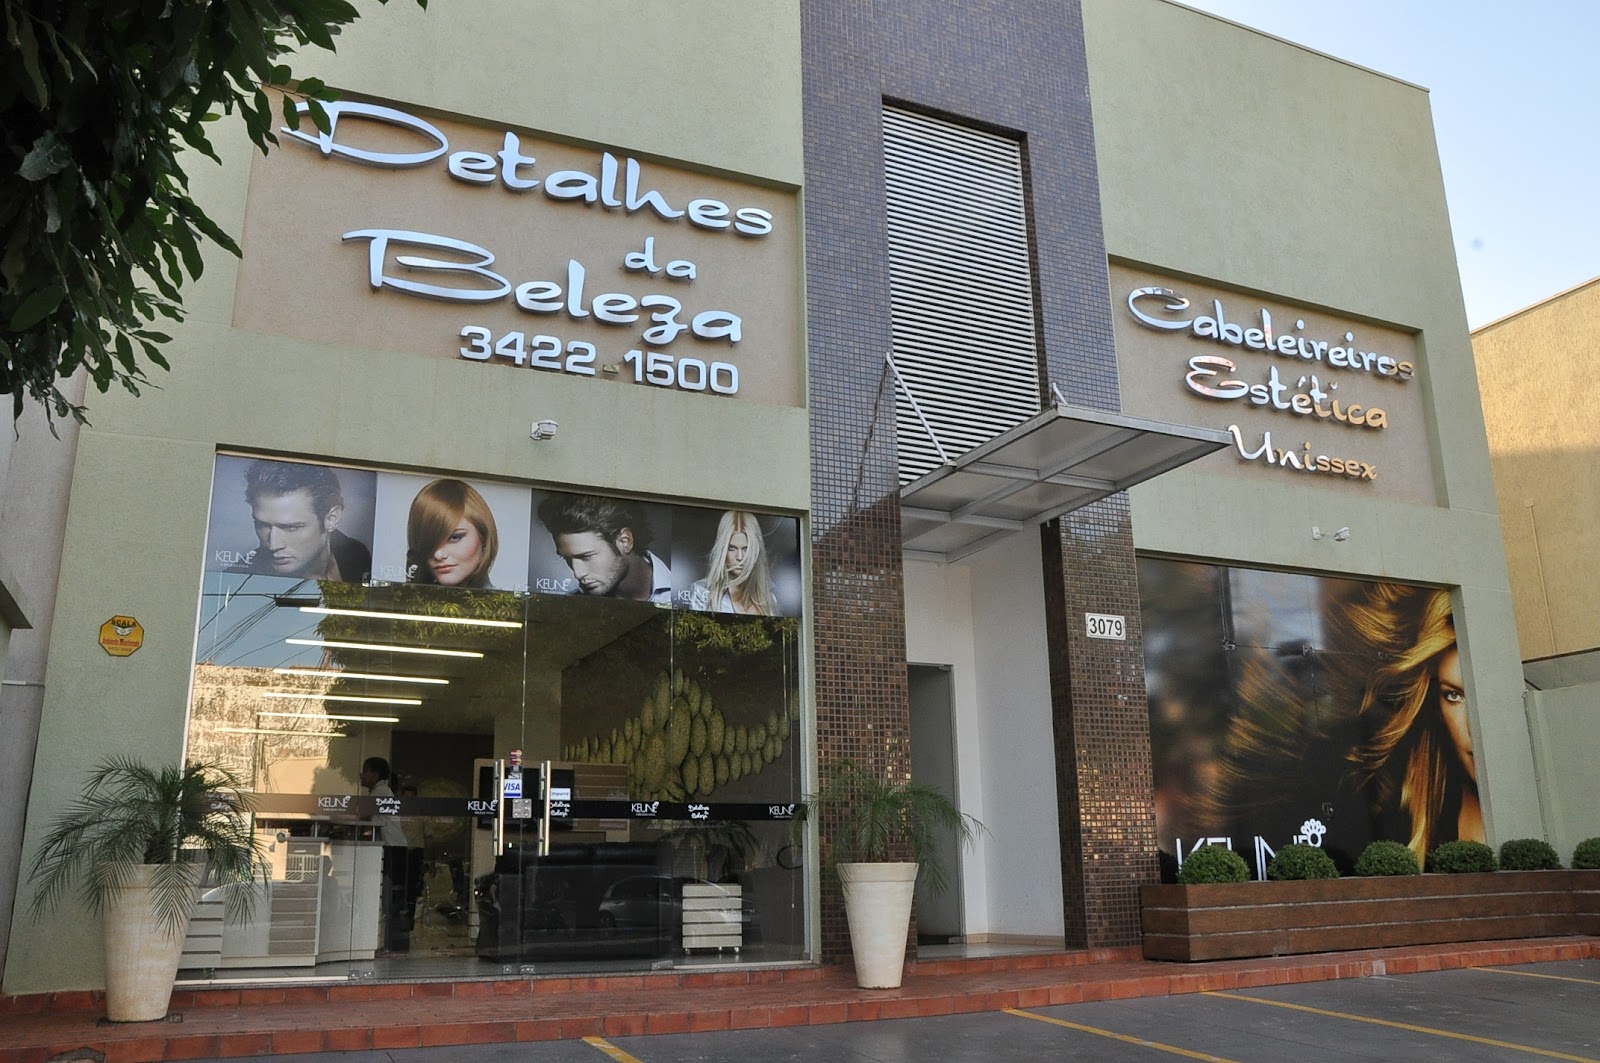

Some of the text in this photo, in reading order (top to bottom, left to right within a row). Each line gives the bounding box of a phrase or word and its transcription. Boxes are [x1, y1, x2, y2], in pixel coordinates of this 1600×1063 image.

[280, 100, 774, 237] Detalhes
[624, 236, 698, 280] da
[342, 228, 742, 346] Beleza
[1128, 286, 1415, 382] Cabeleireiros
[459, 325, 596, 376] 3422
[624, 348, 739, 395] 1500
[1185, 354, 1389, 430] Estética
[1227, 424, 1378, 481] Unissex
[214, 549, 257, 565] KEUNE
[536, 577, 572, 592] KEUNE
[111, 619, 137, 627] SCALA
[1089, 617, 1123, 637] 3079
[503, 782, 521, 792] VISA
[317, 795, 352, 808] KEUNE
[467, 799, 498, 812] KEUNE
[631, 801, 659, 814] KEUNE
[768, 804, 795, 816] KEUNE
